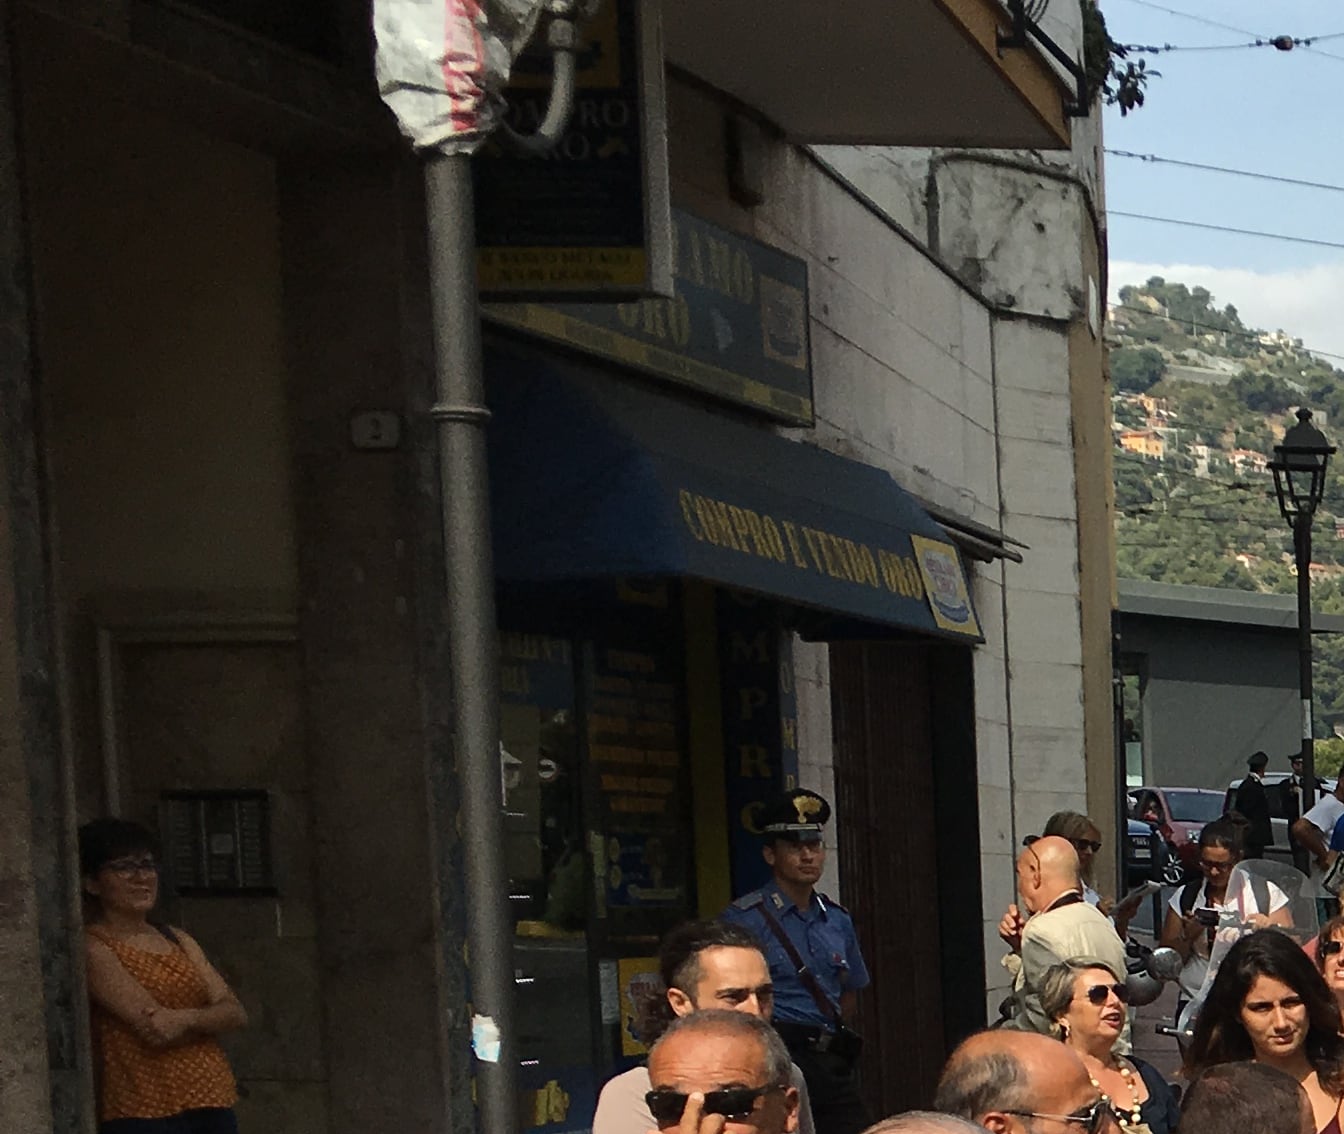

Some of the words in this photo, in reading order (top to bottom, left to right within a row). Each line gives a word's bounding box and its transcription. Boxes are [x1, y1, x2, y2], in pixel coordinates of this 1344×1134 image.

[678, 488, 787, 562] COMPRO
[783, 520, 807, 568] E
[801, 525, 879, 588] VENDO
[876, 547, 923, 600] ORO
